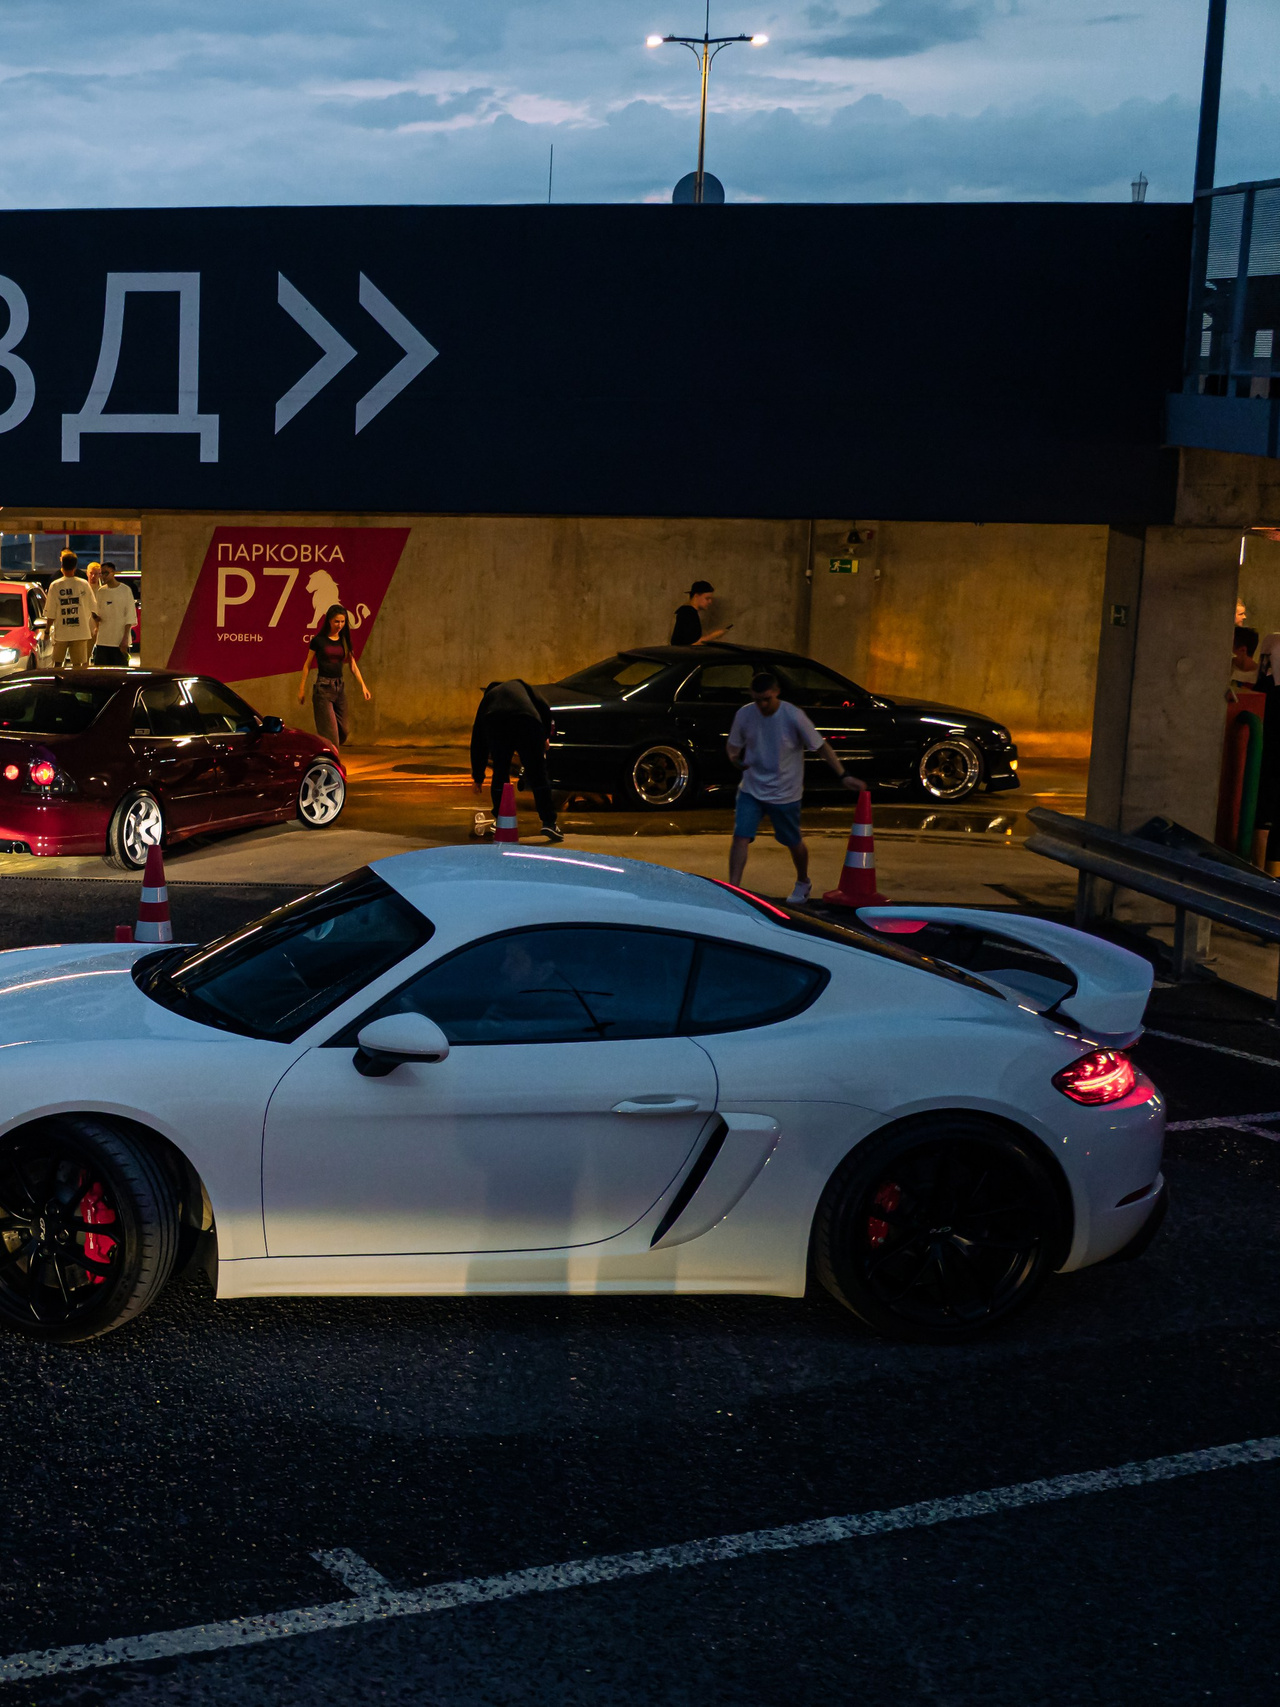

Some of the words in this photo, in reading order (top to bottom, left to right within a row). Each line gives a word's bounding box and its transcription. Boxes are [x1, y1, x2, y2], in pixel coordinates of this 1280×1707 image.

[217, 543, 345, 563] ПАРКОВКА
[216, 566, 300, 628] P7
[216, 633, 264, 643] УРОВЕНЬ
